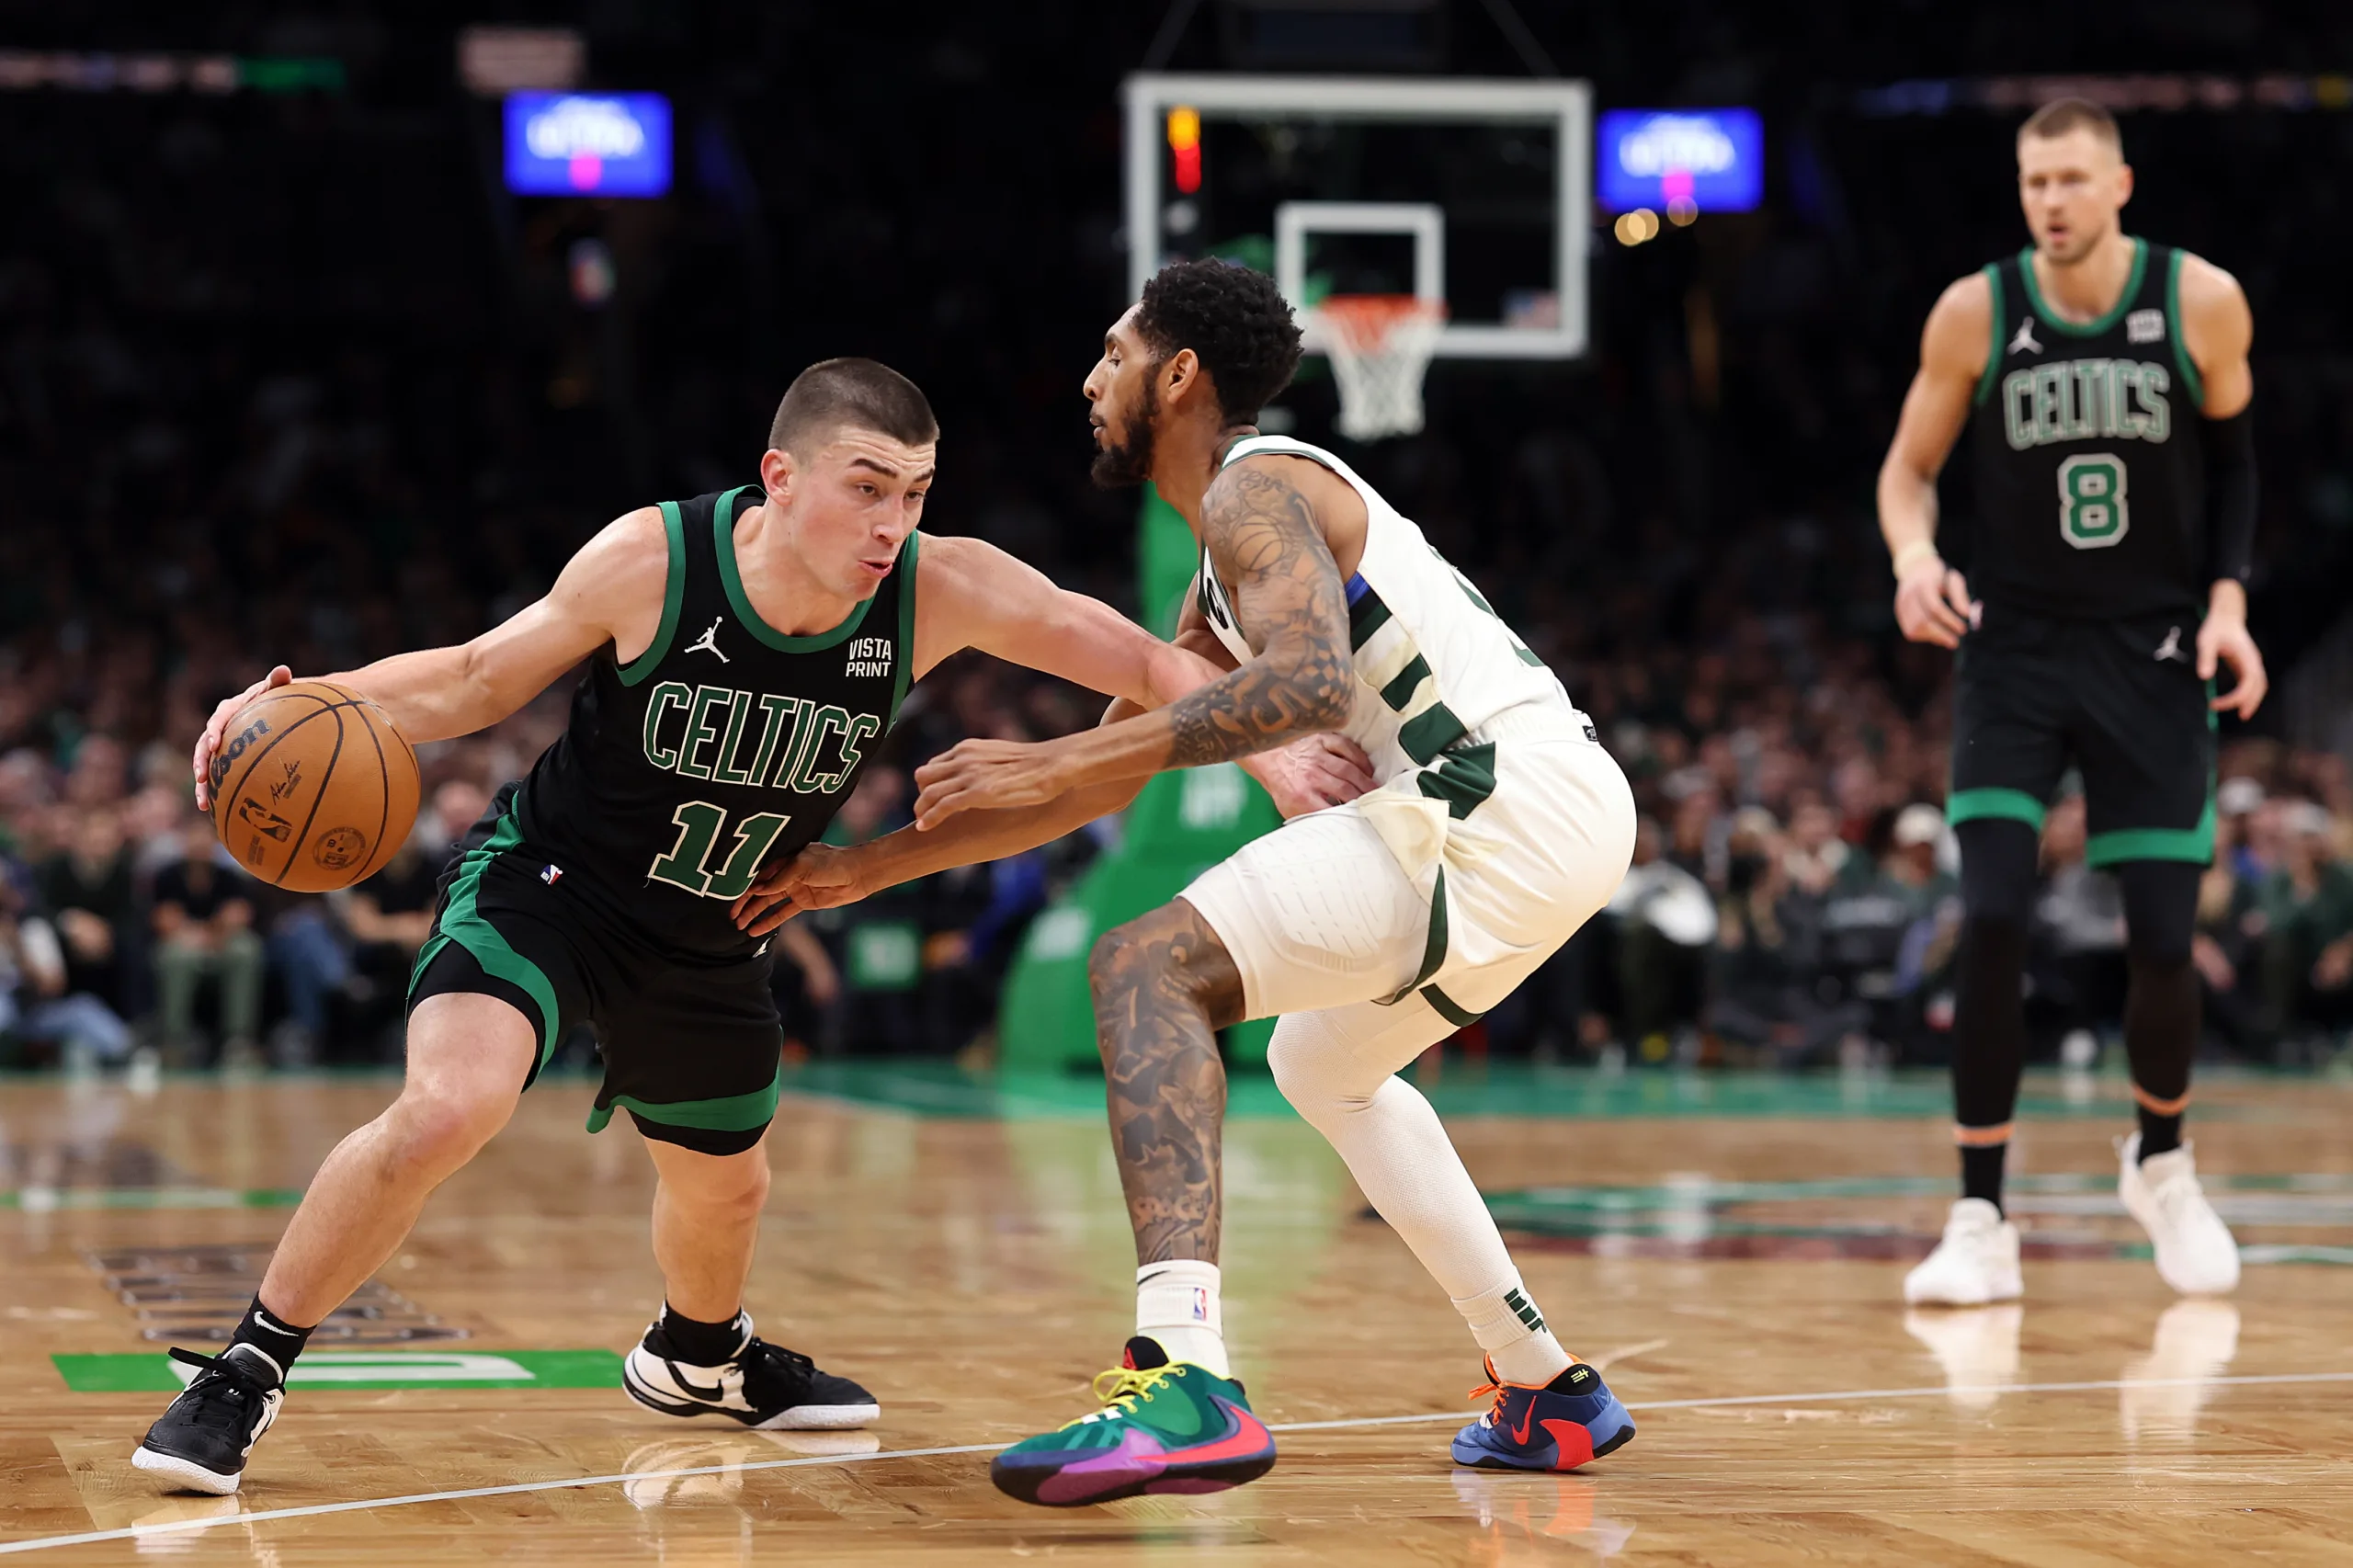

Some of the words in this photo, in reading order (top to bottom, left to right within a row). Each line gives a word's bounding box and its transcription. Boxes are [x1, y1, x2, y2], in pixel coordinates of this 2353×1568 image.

[2002, 358, 2171, 451] CELTICS
[2057, 452, 2130, 550] 8
[846, 661, 892, 678] PRINT
[848, 637, 892, 662] VISTA
[208, 719, 272, 801] lson
[643, 680, 881, 793] CELTICS
[647, 800, 791, 901] 11
